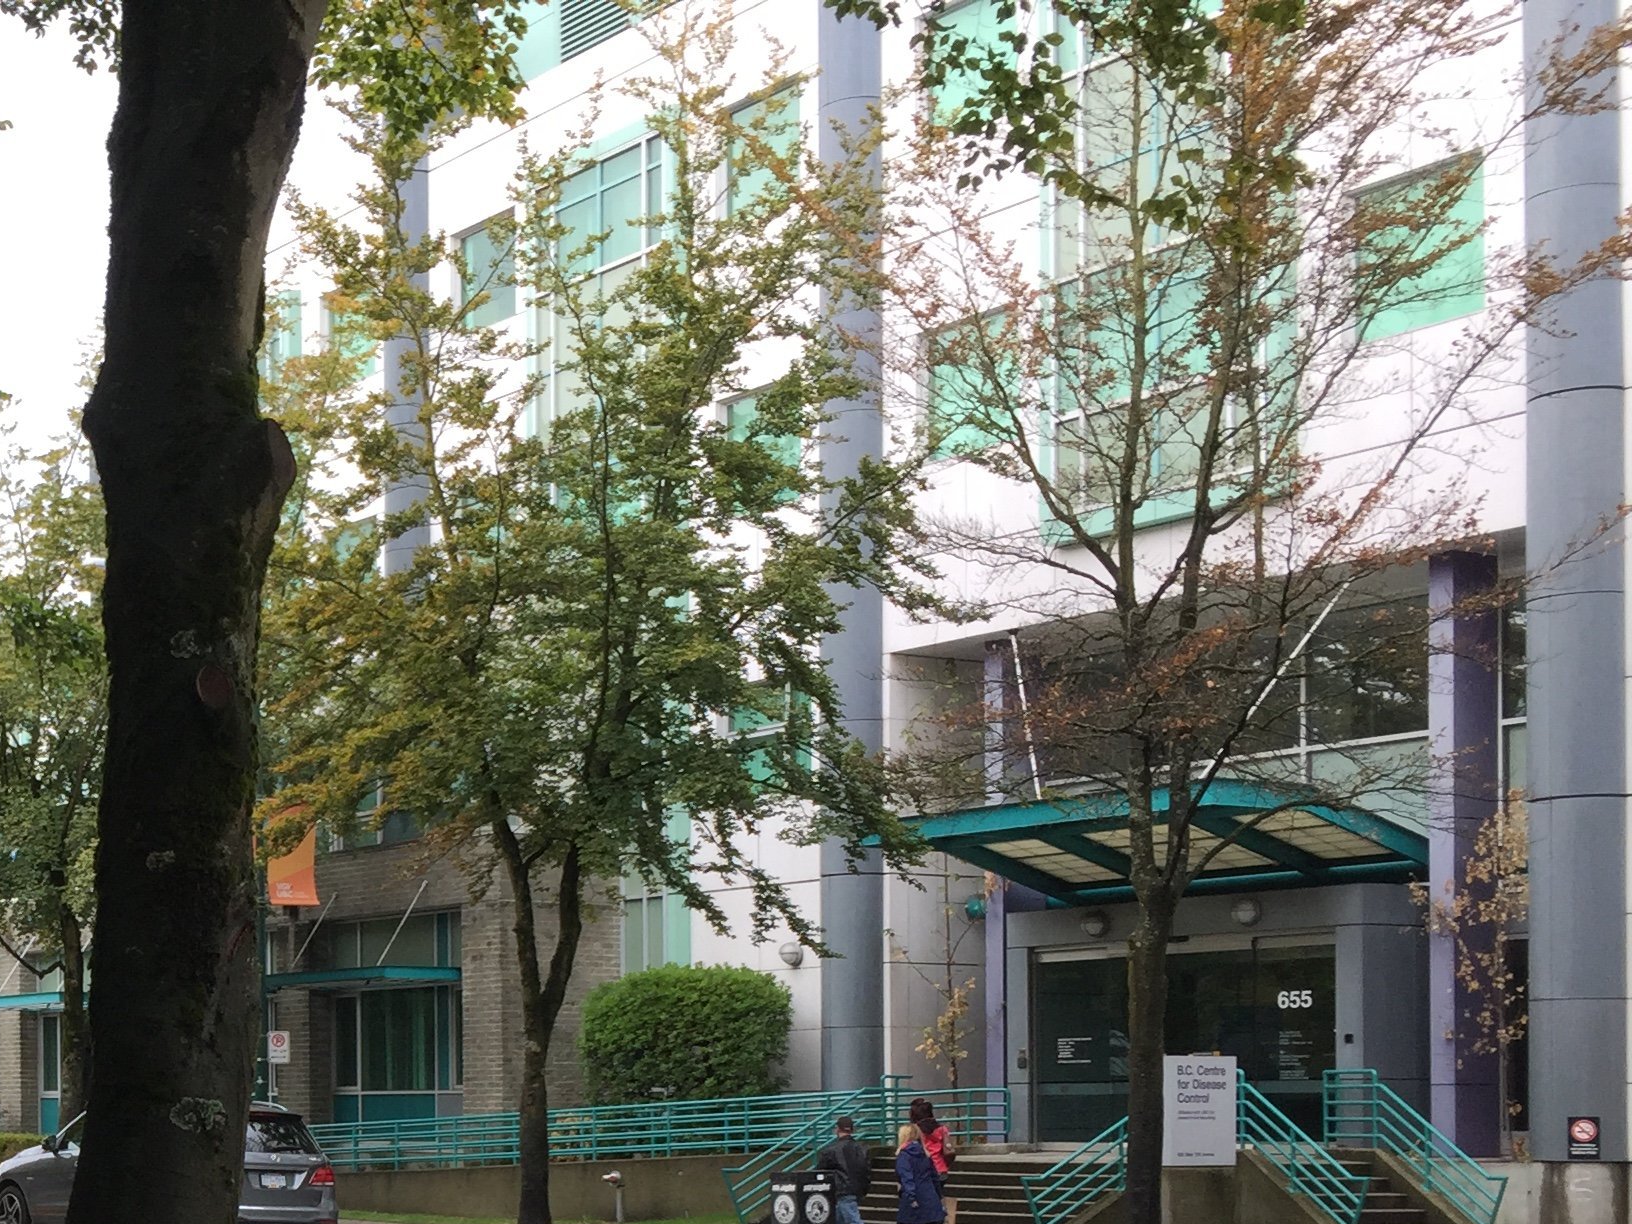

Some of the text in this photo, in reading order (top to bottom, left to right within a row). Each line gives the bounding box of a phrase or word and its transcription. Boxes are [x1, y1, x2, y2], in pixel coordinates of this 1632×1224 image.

[1277, 990, 1313, 1009] 655
[1177, 1065, 1226, 1076] B.C. Centre
[1177, 1079, 1227, 1090] for Disease
[1177, 1092, 1210, 1103] Control
